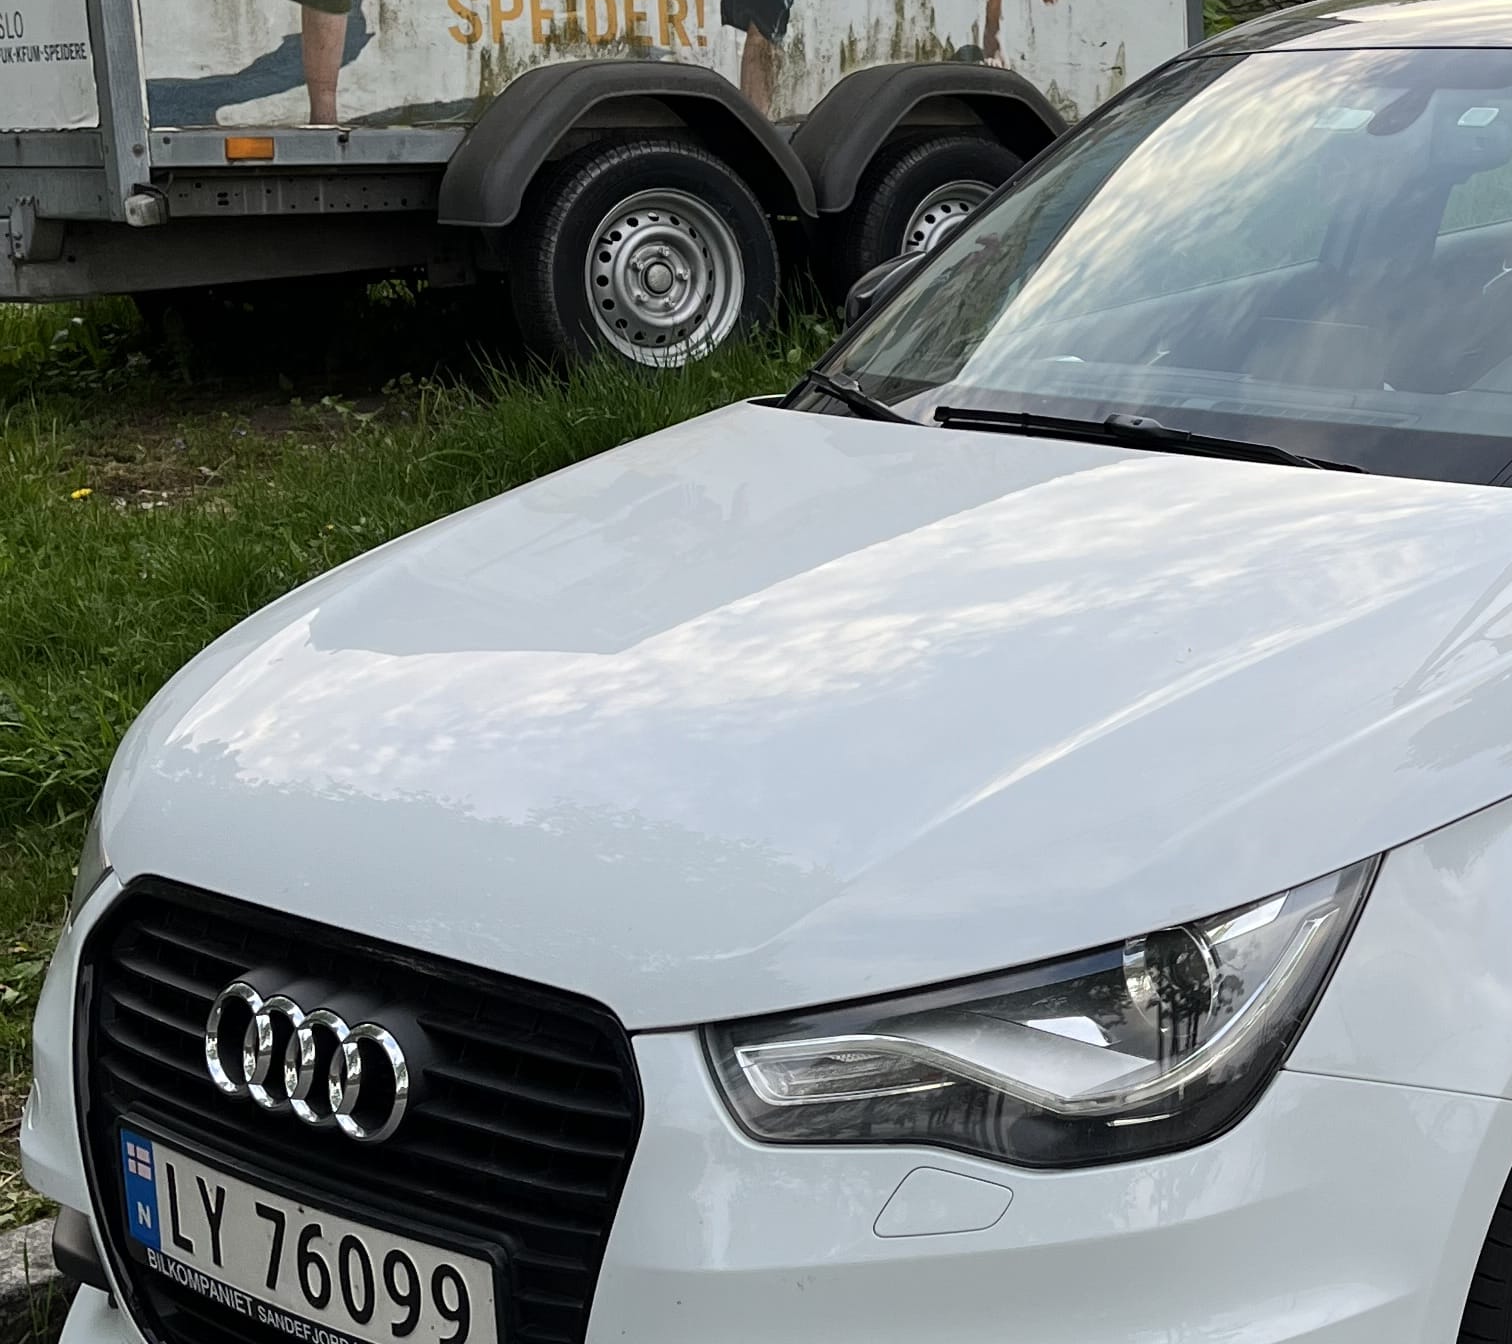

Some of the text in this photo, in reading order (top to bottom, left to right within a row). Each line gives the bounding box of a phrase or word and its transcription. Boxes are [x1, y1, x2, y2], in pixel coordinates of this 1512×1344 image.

[136, 1201, 151, 1229] N
[165, 1161, 226, 1268] LY
[147, 1247, 253, 1316] BILKOMPANIET
